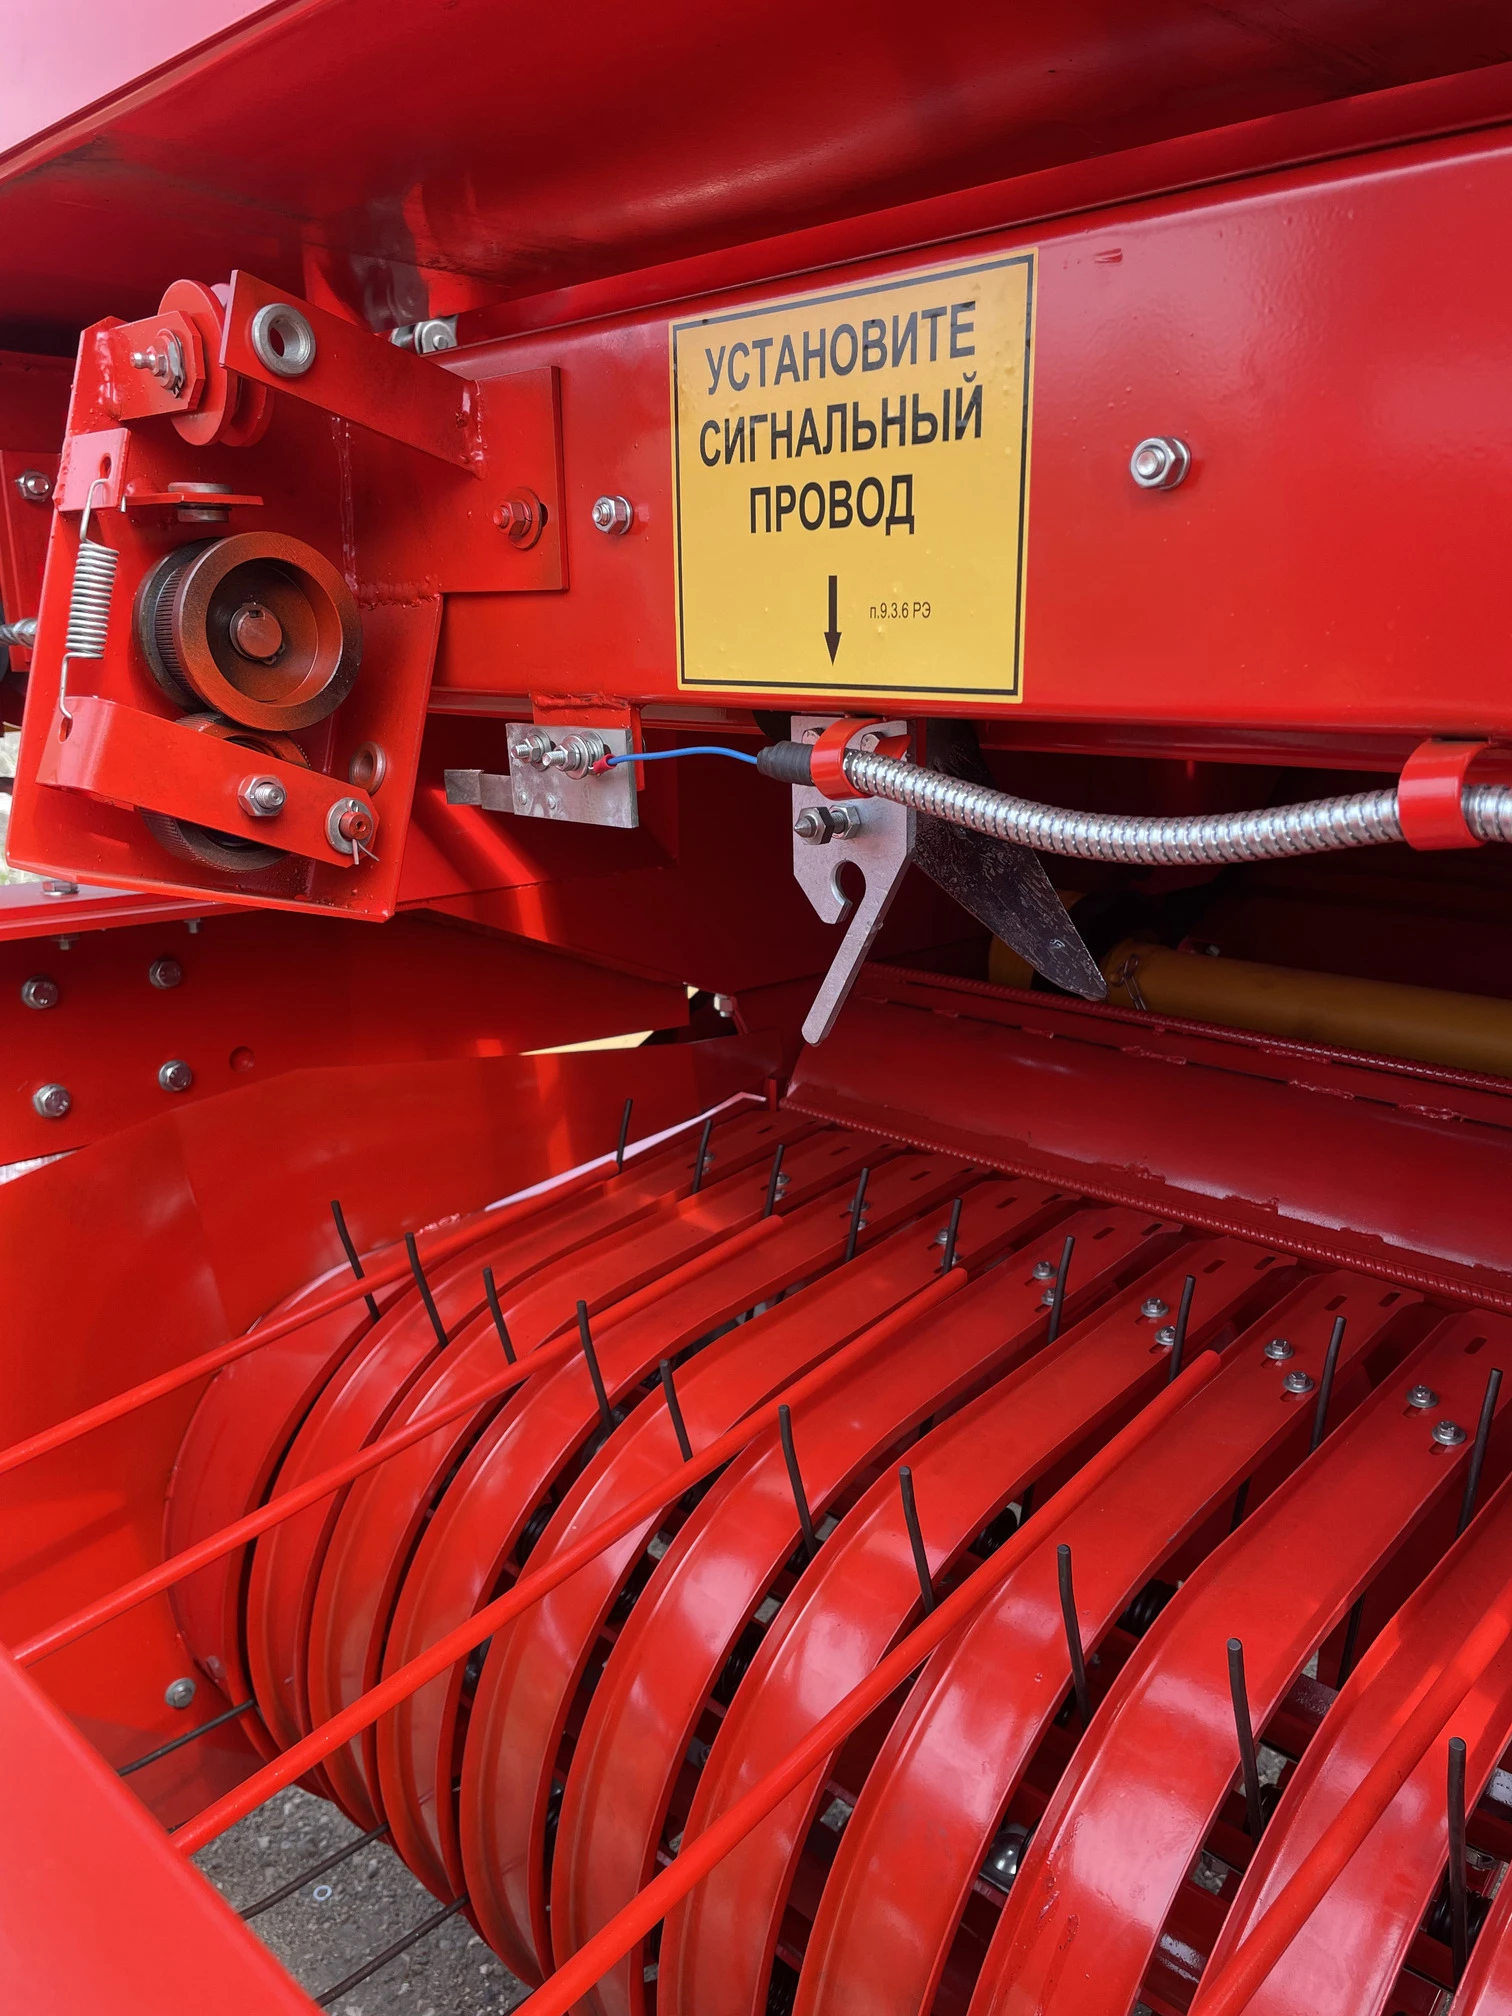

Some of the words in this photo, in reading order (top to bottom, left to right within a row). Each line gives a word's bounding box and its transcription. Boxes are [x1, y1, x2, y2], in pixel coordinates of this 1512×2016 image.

[705, 301, 976, 395] УСТАНОВИТЕ
[700, 371, 983, 467] СИГНАЛЬНЫЙ
[750, 474, 915, 536] ПРОВОД
[869, 602, 909, 619] п.9.3.6
[913, 602, 931, 618] РЭ
